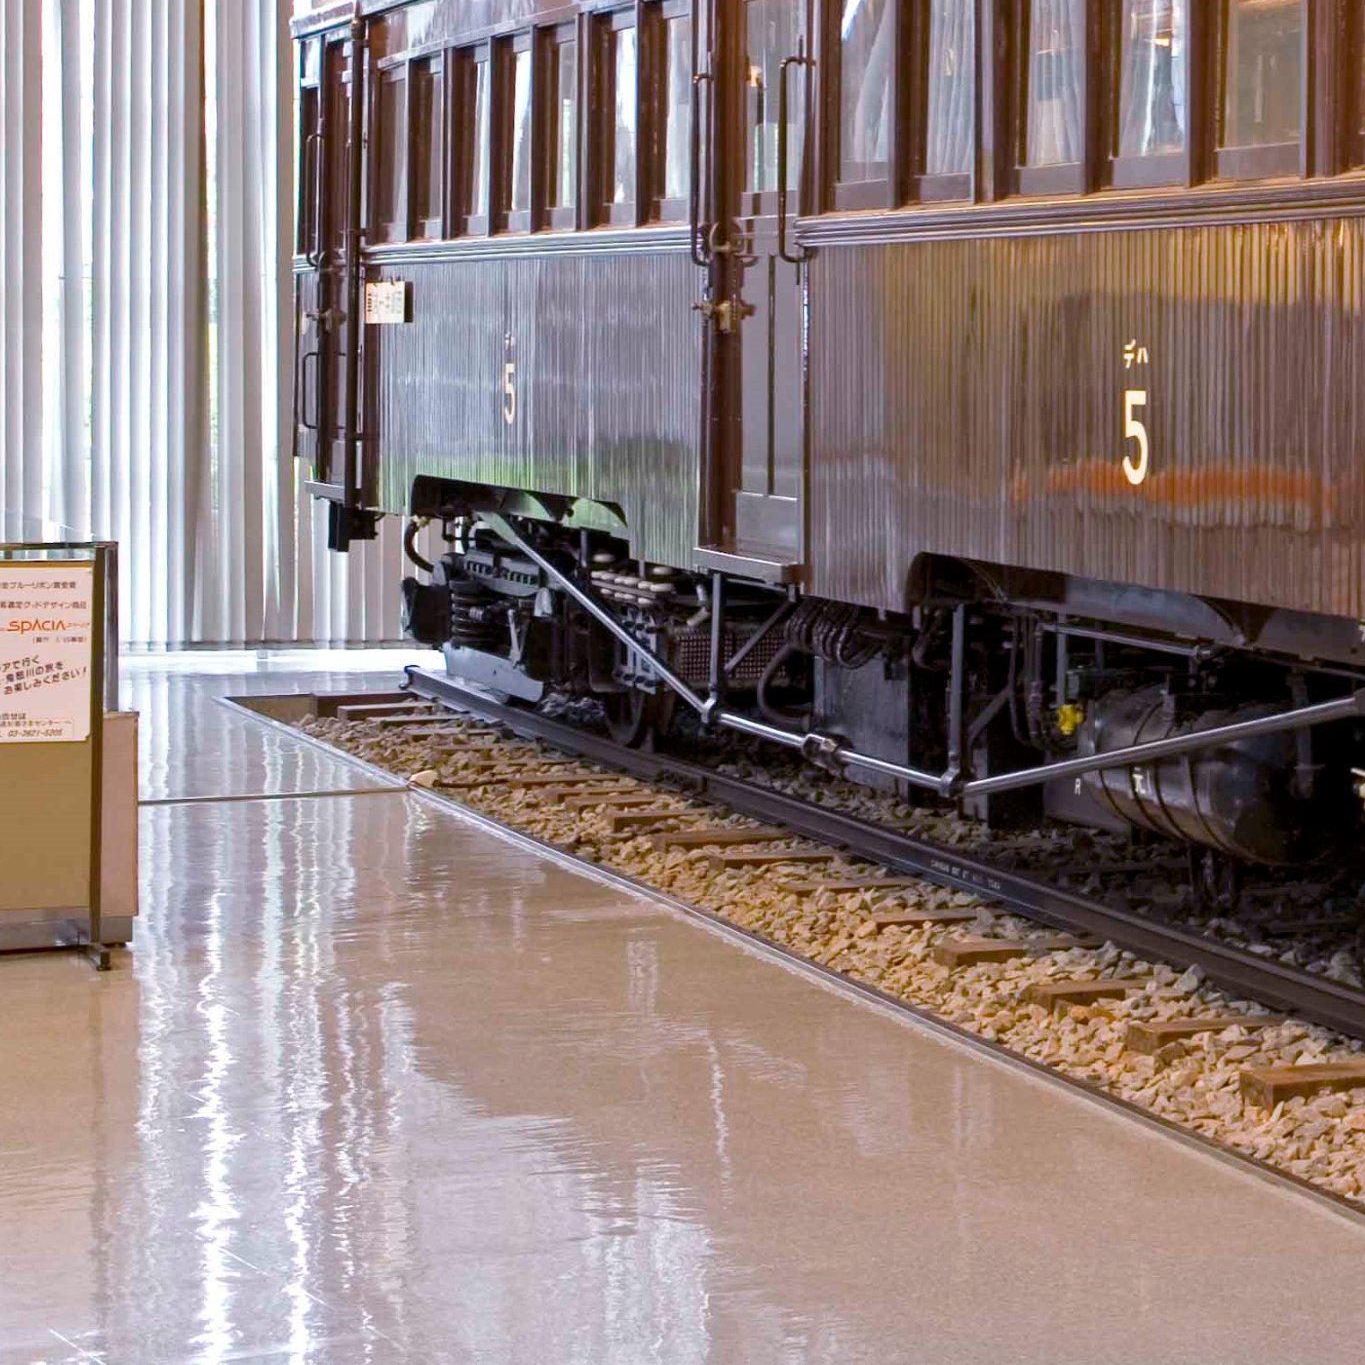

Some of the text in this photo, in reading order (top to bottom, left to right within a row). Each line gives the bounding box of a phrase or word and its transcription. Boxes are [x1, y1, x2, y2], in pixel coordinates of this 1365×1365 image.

[1123, 339, 1148, 369] デハ
[504, 363, 515, 424] 5
[1122, 390, 1148, 485] 5
